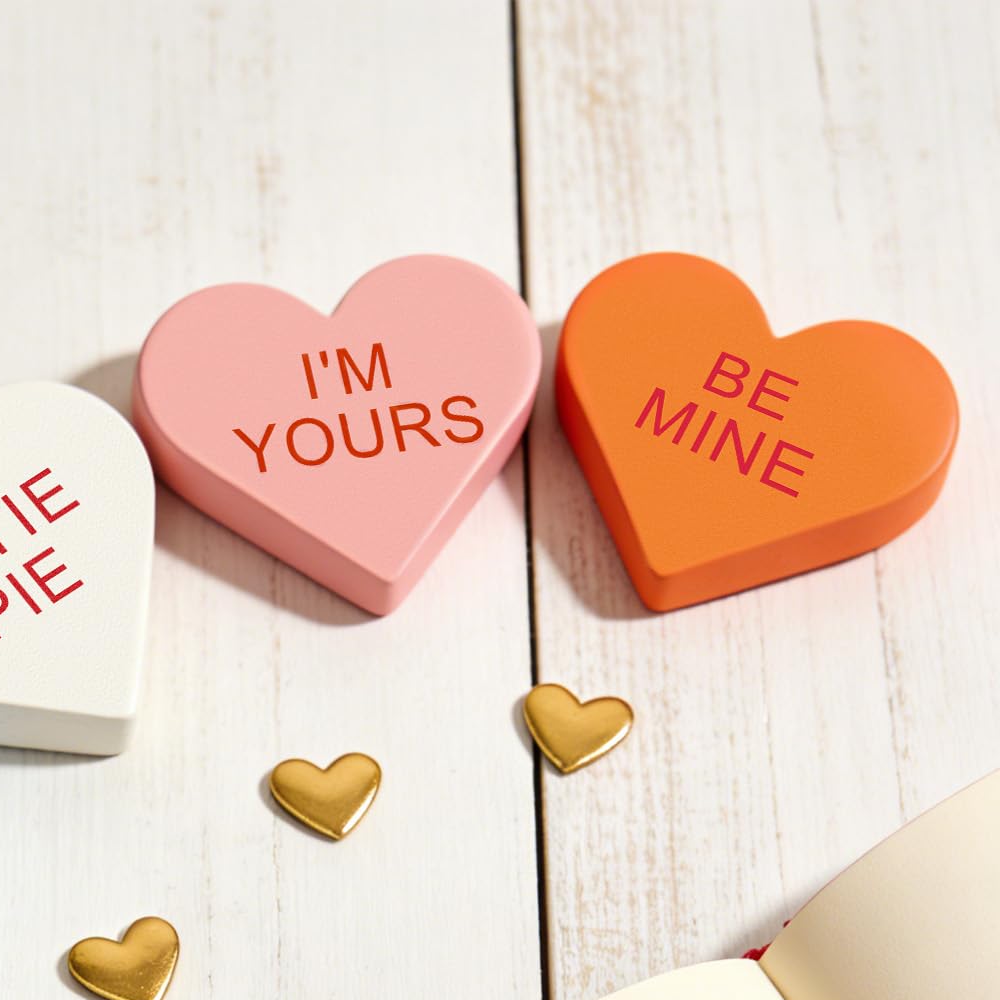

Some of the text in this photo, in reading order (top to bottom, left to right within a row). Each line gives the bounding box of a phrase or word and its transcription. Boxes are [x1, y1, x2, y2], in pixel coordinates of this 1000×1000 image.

[301, 342, 392, 399] I'M
[703, 352, 799, 421] BE
[232, 395, 484, 473] YOURS
[635, 387, 814, 498] MINE
